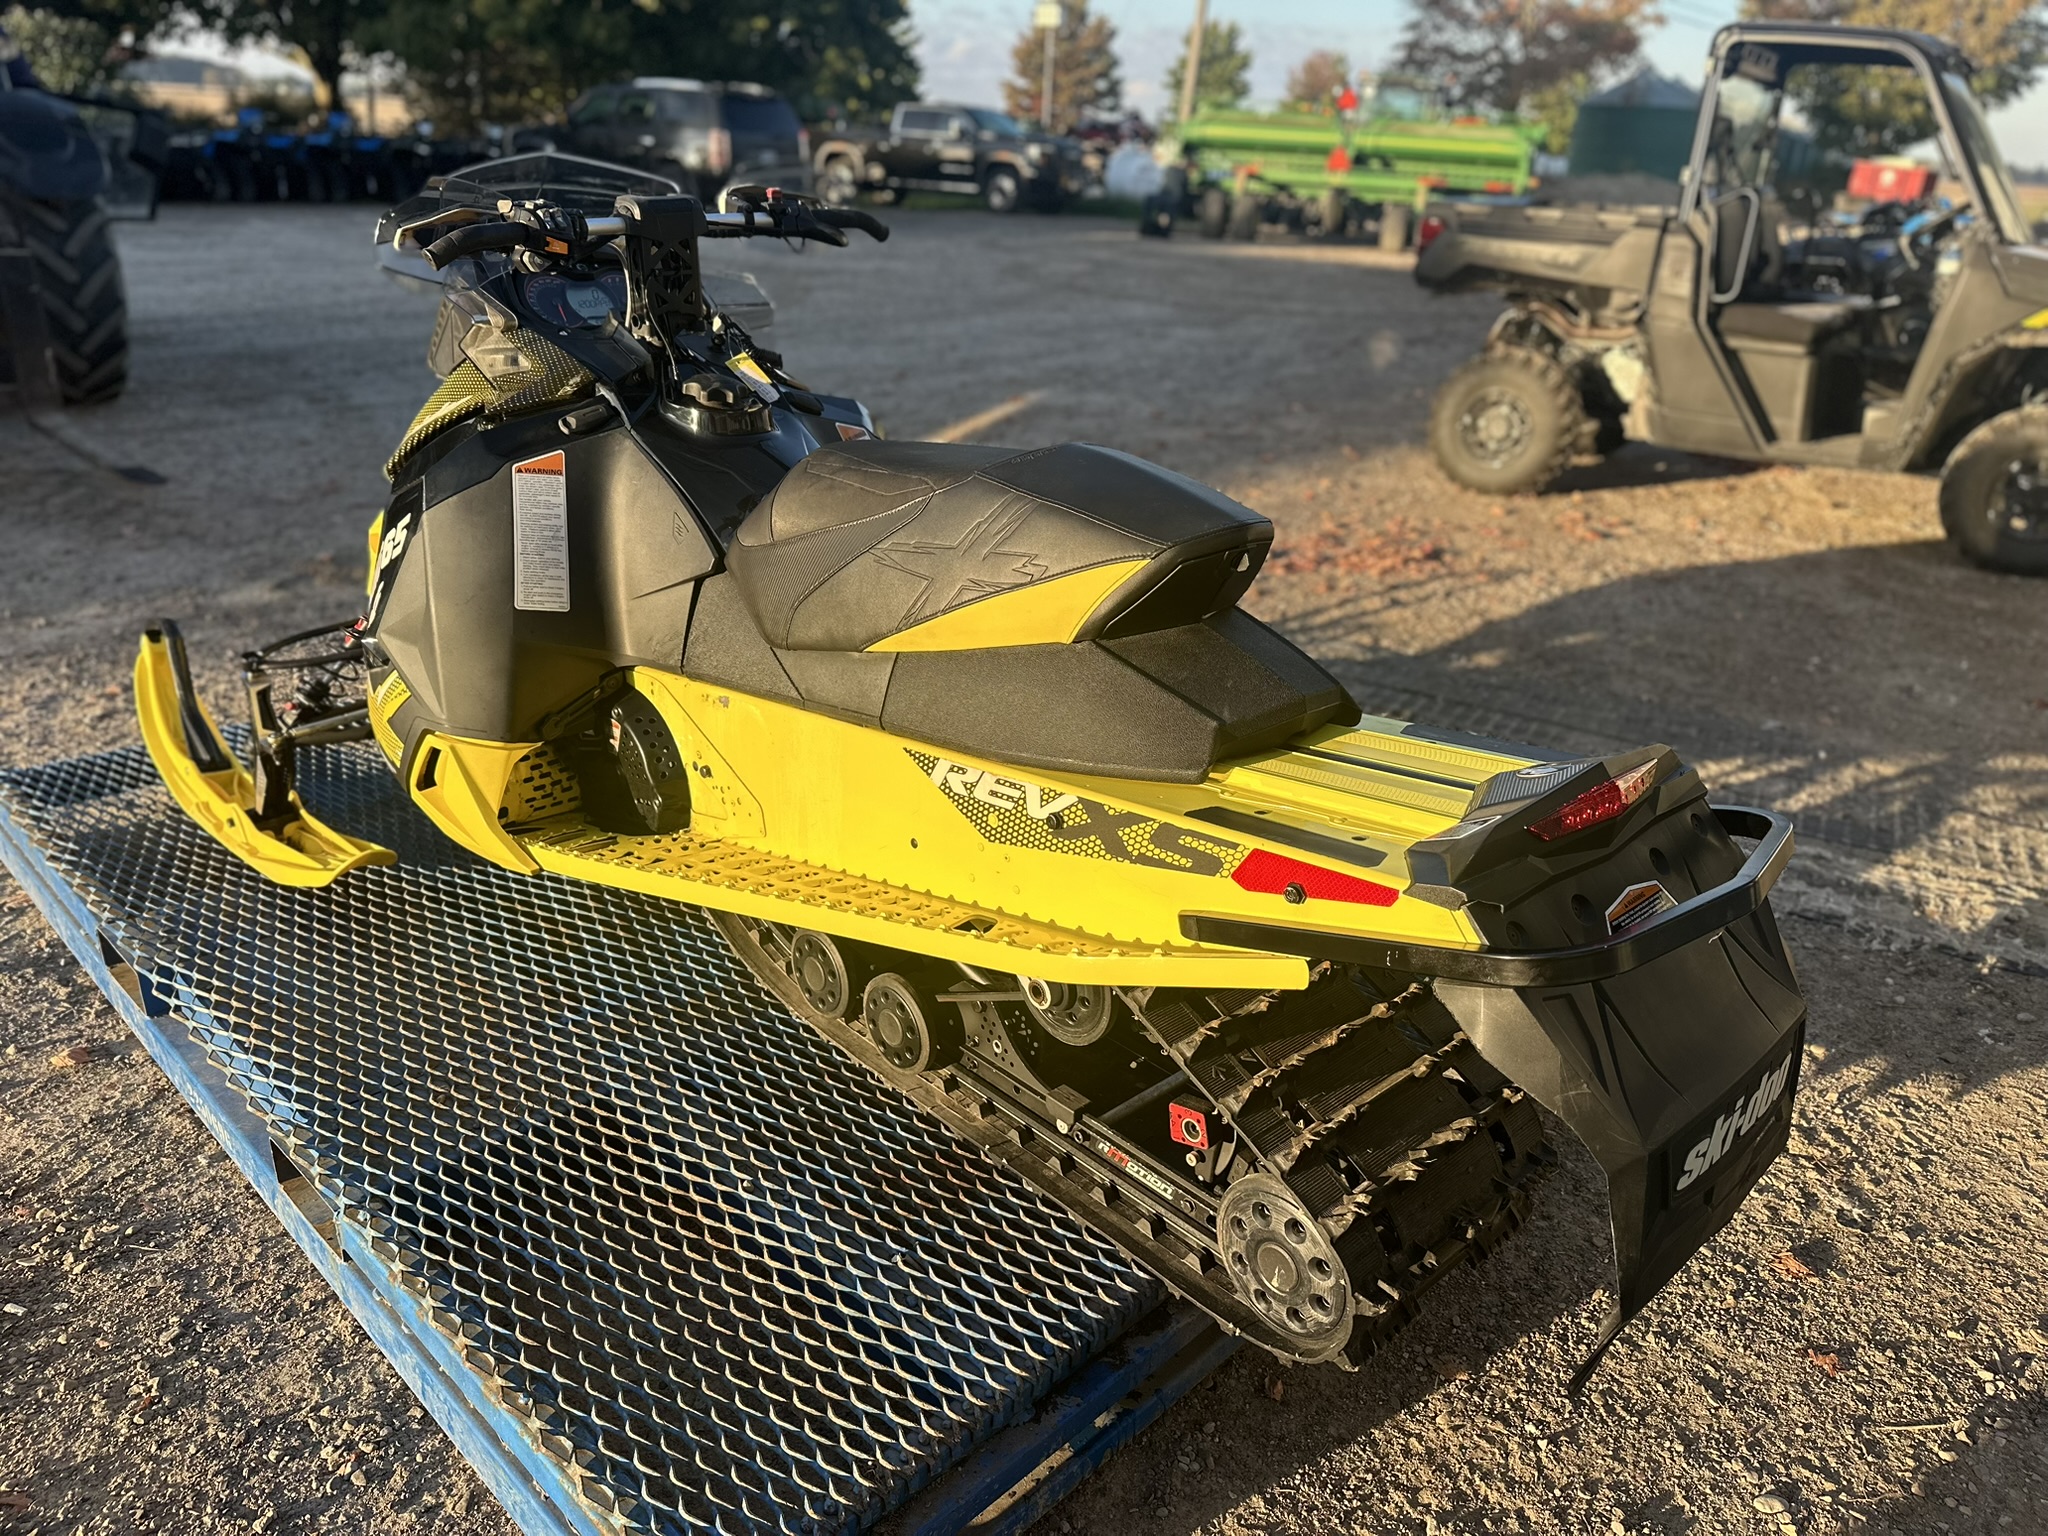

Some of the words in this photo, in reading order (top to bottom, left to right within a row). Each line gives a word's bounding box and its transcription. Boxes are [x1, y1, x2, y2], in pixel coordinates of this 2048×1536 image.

[524, 467, 563, 476] WARNING
[930, 758, 1080, 819] REV
[1052, 797, 1242, 877] XS
[1627, 891, 1647, 908] WARNING
[1676, 1052, 1792, 1191] ski-doo
